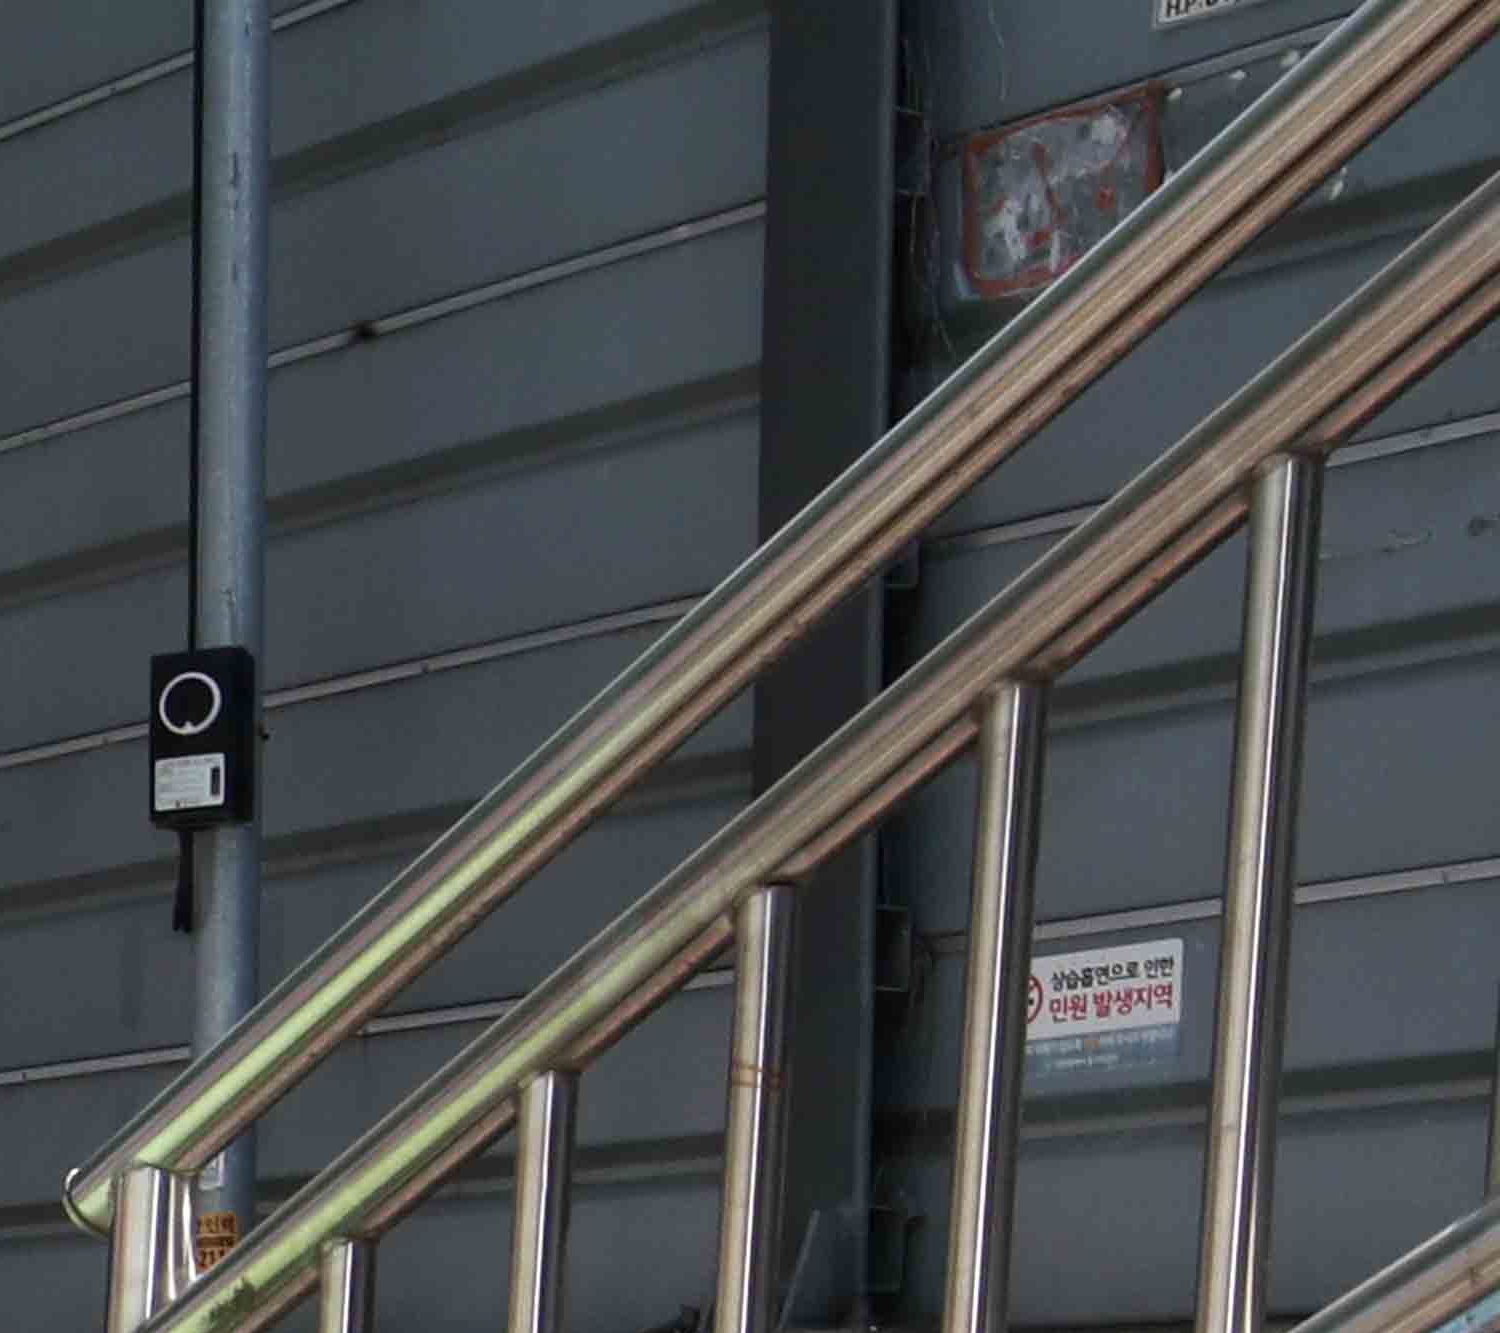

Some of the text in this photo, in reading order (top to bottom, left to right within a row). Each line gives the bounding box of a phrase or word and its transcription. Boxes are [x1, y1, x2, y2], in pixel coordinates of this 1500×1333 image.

[1143, 956, 1175, 981] 인한
[1049, 983, 1175, 1024] 민원 발생지역
